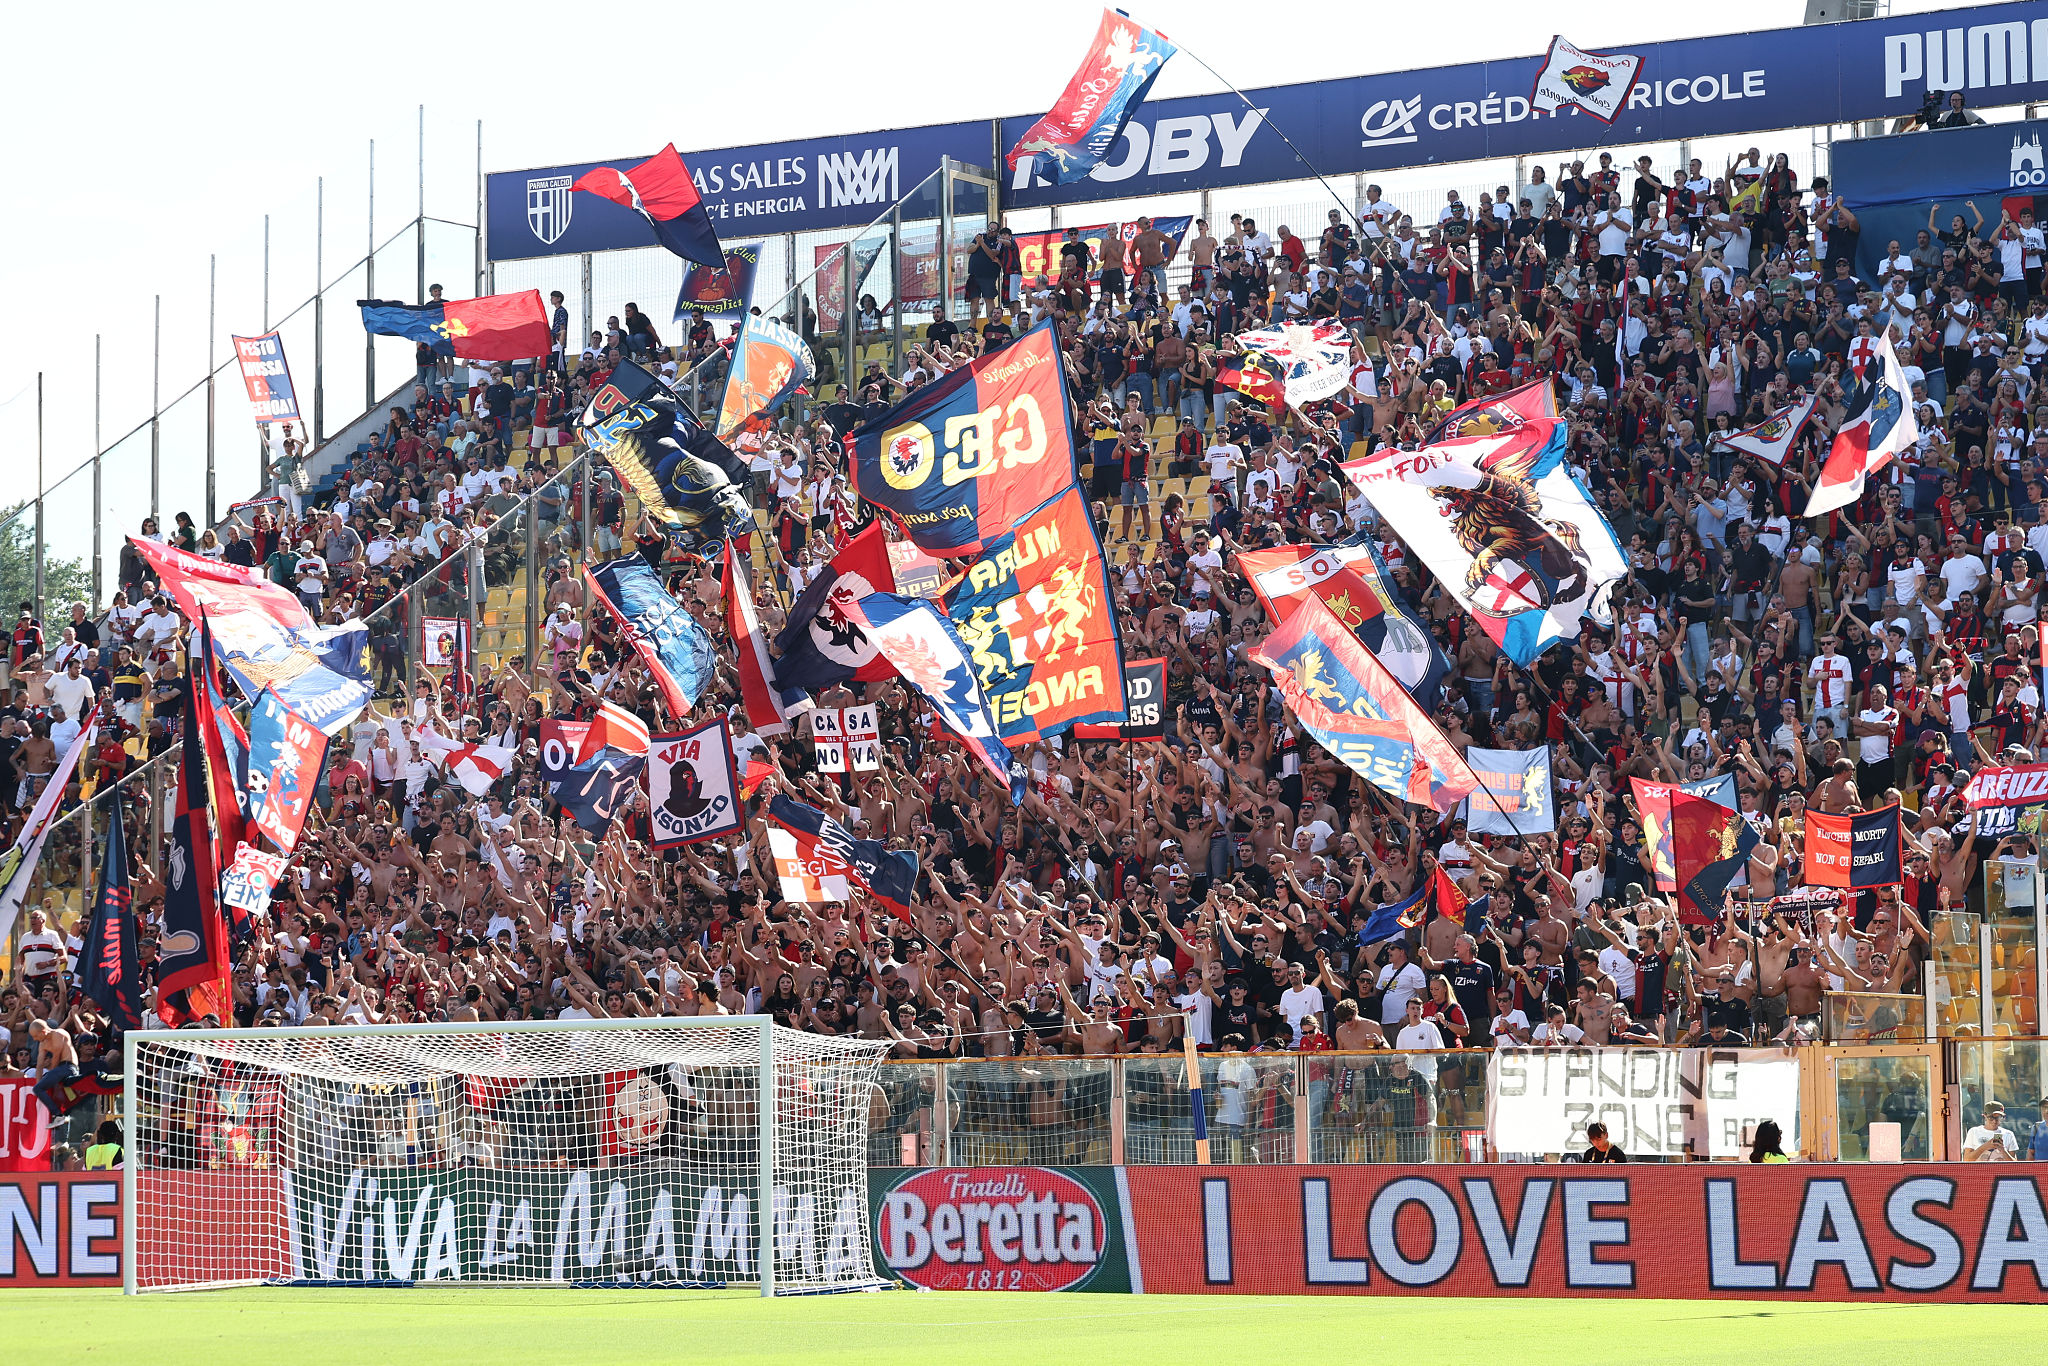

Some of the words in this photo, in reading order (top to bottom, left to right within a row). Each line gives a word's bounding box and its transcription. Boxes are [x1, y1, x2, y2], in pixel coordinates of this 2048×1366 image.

[1428, 91, 1557, 130] CRÉD
[529, 180, 549, 191] PARMA
[551, 177, 572, 188] CALCIO
[696, 163, 725, 194] AS
[730, 156, 806, 192] SALES
[2010, 170, 2045, 187] 100
[734, 196, 806, 217] ENERGIA
[734, 247, 757, 264] Club
[238, 339, 277, 356] PESTO
[242, 360, 286, 377] MUSSA
[838, 734, 866, 742] TREBBIA
[657, 739, 701, 766] VIA
[1509, 773, 1523, 791] IS
[1643, 782, 1722, 799] SBADATI
[1471, 791, 1521, 813] GENOA
[653, 793, 730, 836] ISONZO
[786, 857, 827, 877] PÊGI
[1815, 852, 1835, 865] NON
[1839, 856, 1850, 867] CI
[1853, 852, 1885, 867] SEPARI
[1778, 890, 1841, 905] GENOA
[1499, 1049, 1739, 1100] STANDING
[1564, 1102, 1695, 1152] ZONE
[943, 1173, 1028, 1199] Fratelli
[480, 1198, 533, 1268] LA
[550, 1168, 861, 1281] MAMMA
[886, 1190, 1097, 1269] Beretta
[1204, 1180, 1232, 1284] I
[1305, 1178, 1635, 1290] LOVE
[963, 1269, 1024, 1291] 1812
